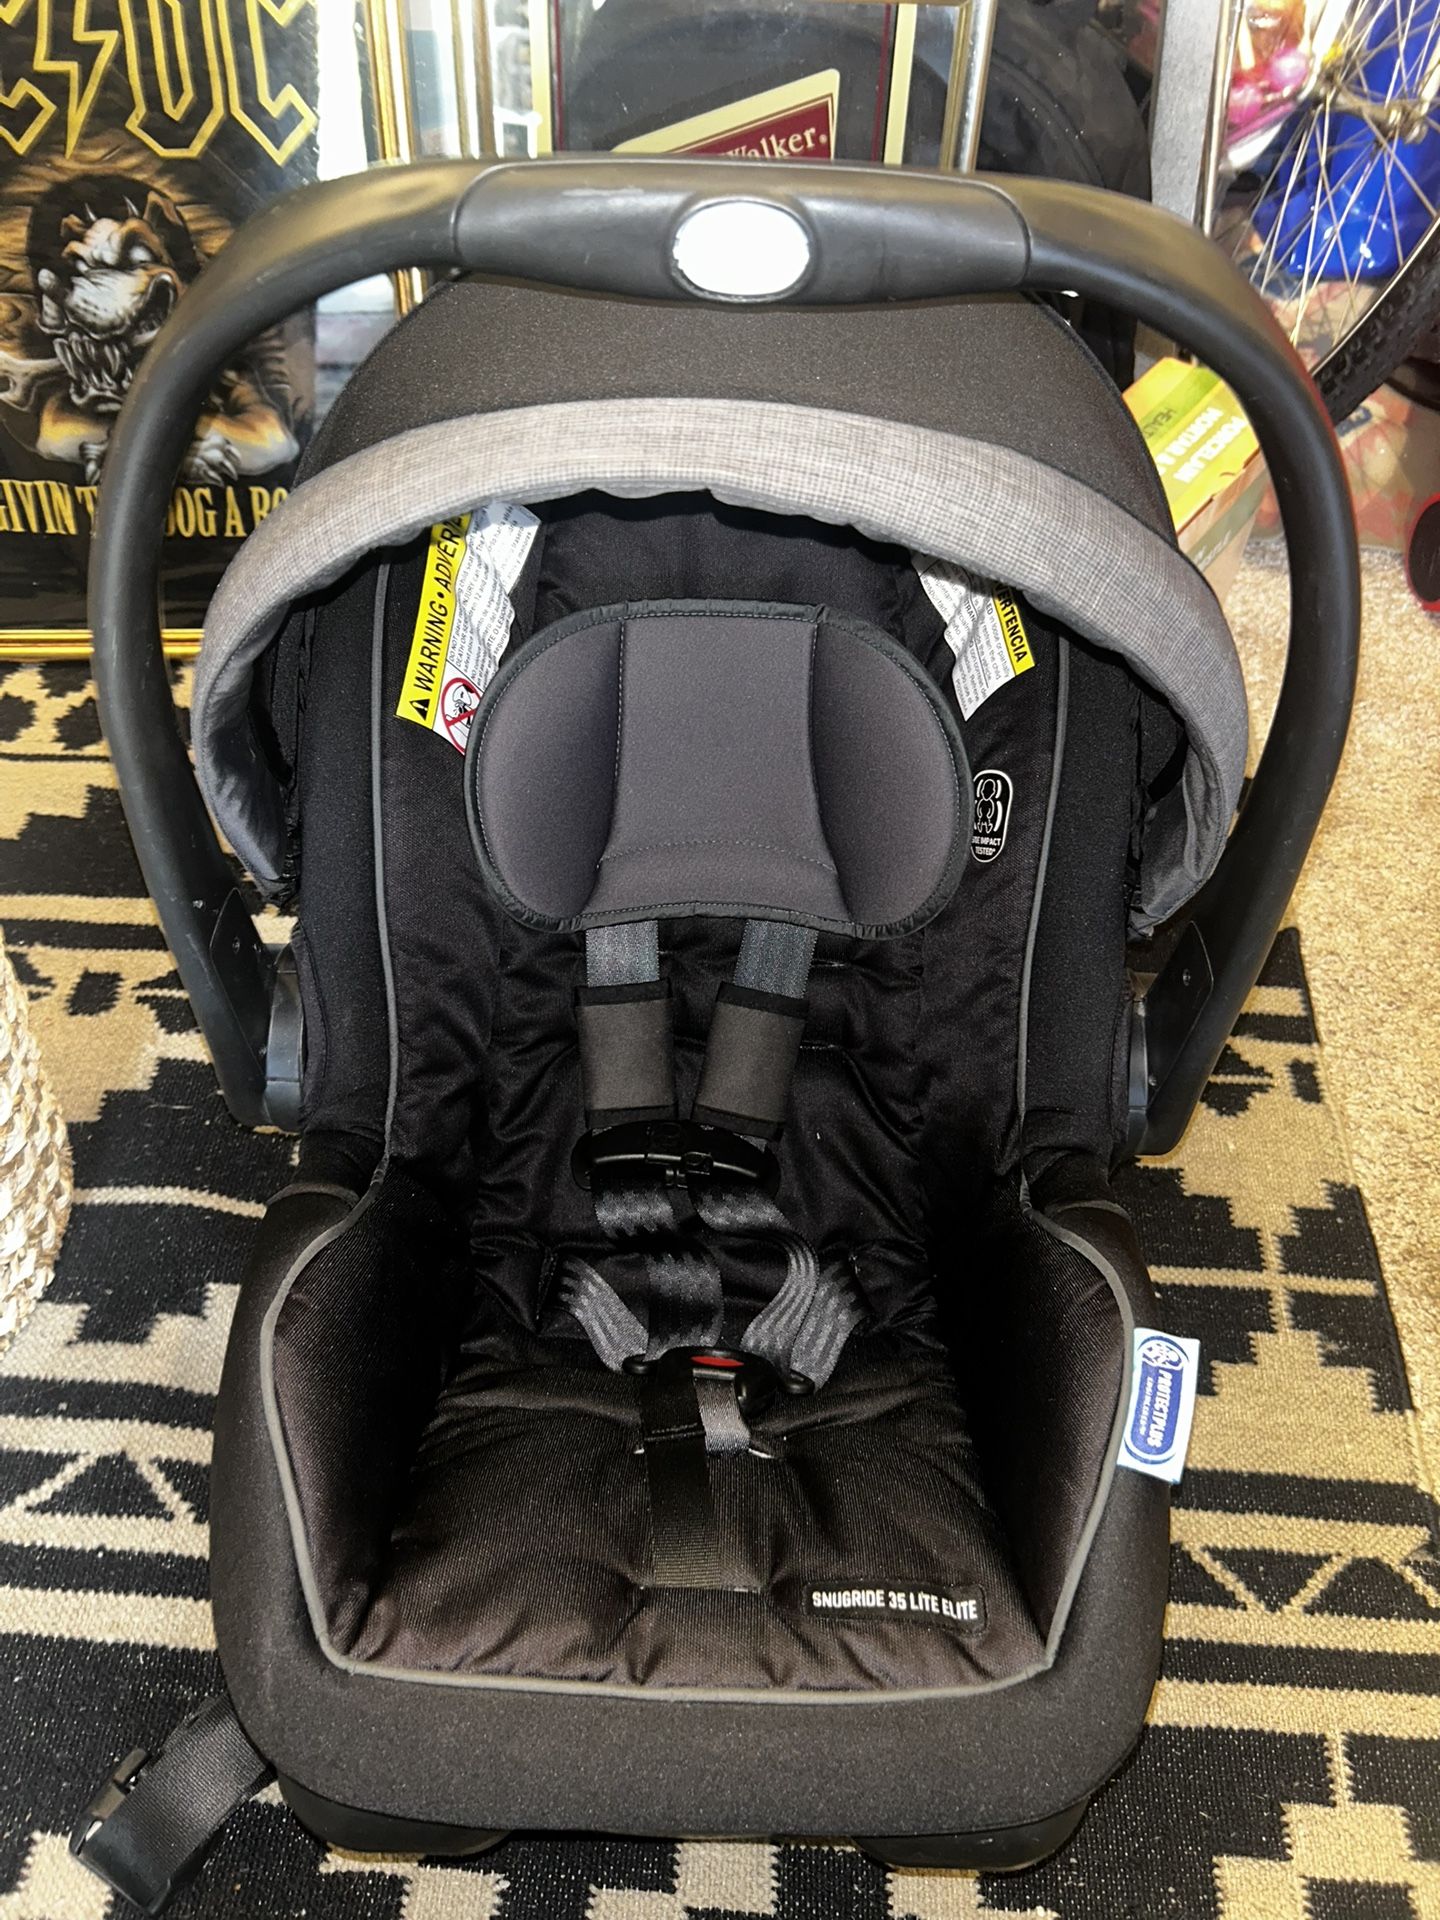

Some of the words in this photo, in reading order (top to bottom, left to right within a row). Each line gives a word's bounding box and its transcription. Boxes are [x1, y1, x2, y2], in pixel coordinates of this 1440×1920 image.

[224, 486, 247, 537] A
[414, 600, 449, 692] WARNING
[812, 1589, 885, 1608] SNUGRIDE
[889, 1591, 907, 1610] 35
[910, 1591, 940, 1614] LITE
[941, 1598, 978, 1620] ELITE
